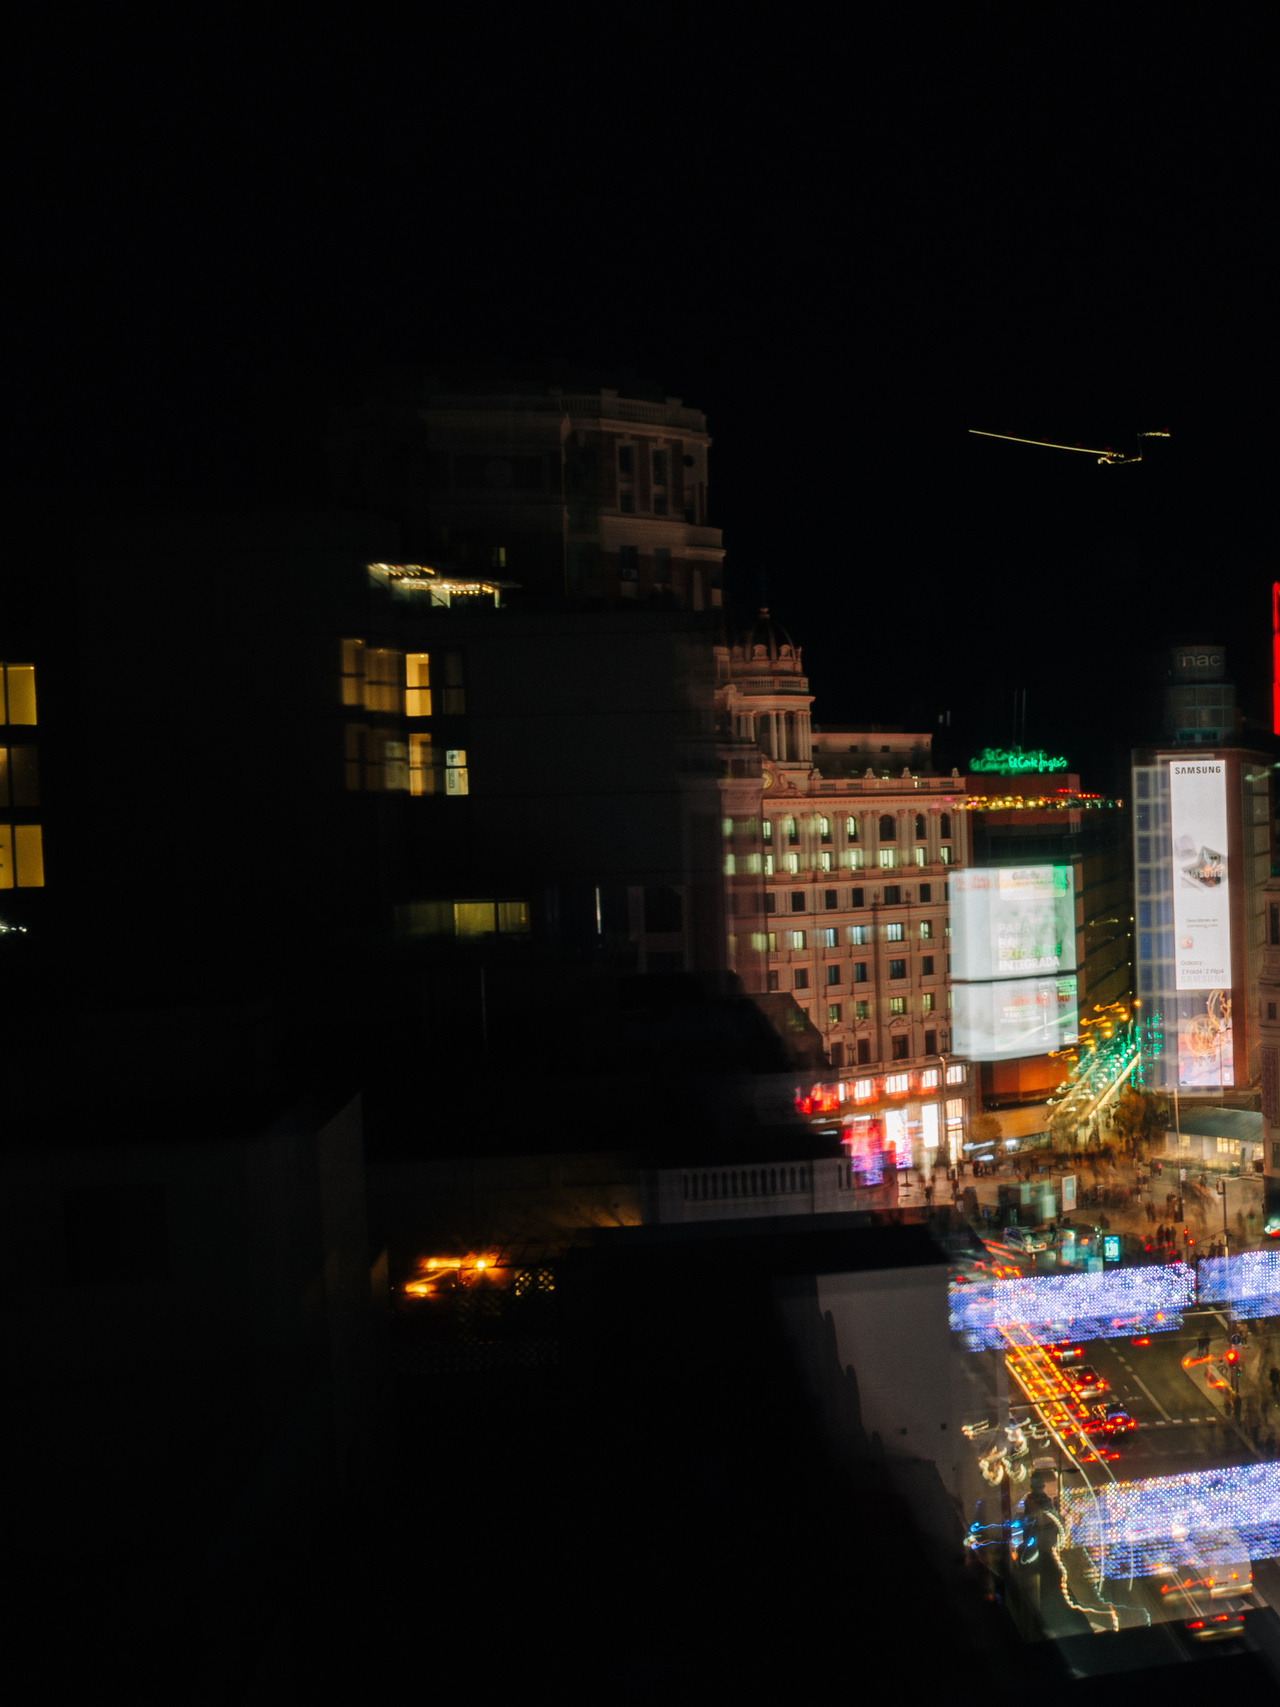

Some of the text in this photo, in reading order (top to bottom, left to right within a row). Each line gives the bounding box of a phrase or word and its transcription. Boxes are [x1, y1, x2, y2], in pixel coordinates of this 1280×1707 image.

[1008, 755, 1018, 768] El
[1018, 756, 1038, 768] Corte
[1038, 753, 1067, 772] Inglés
[1174, 766, 1221, 774] SAMSUNG
[998, 956, 1060, 971] INTEGRADA
